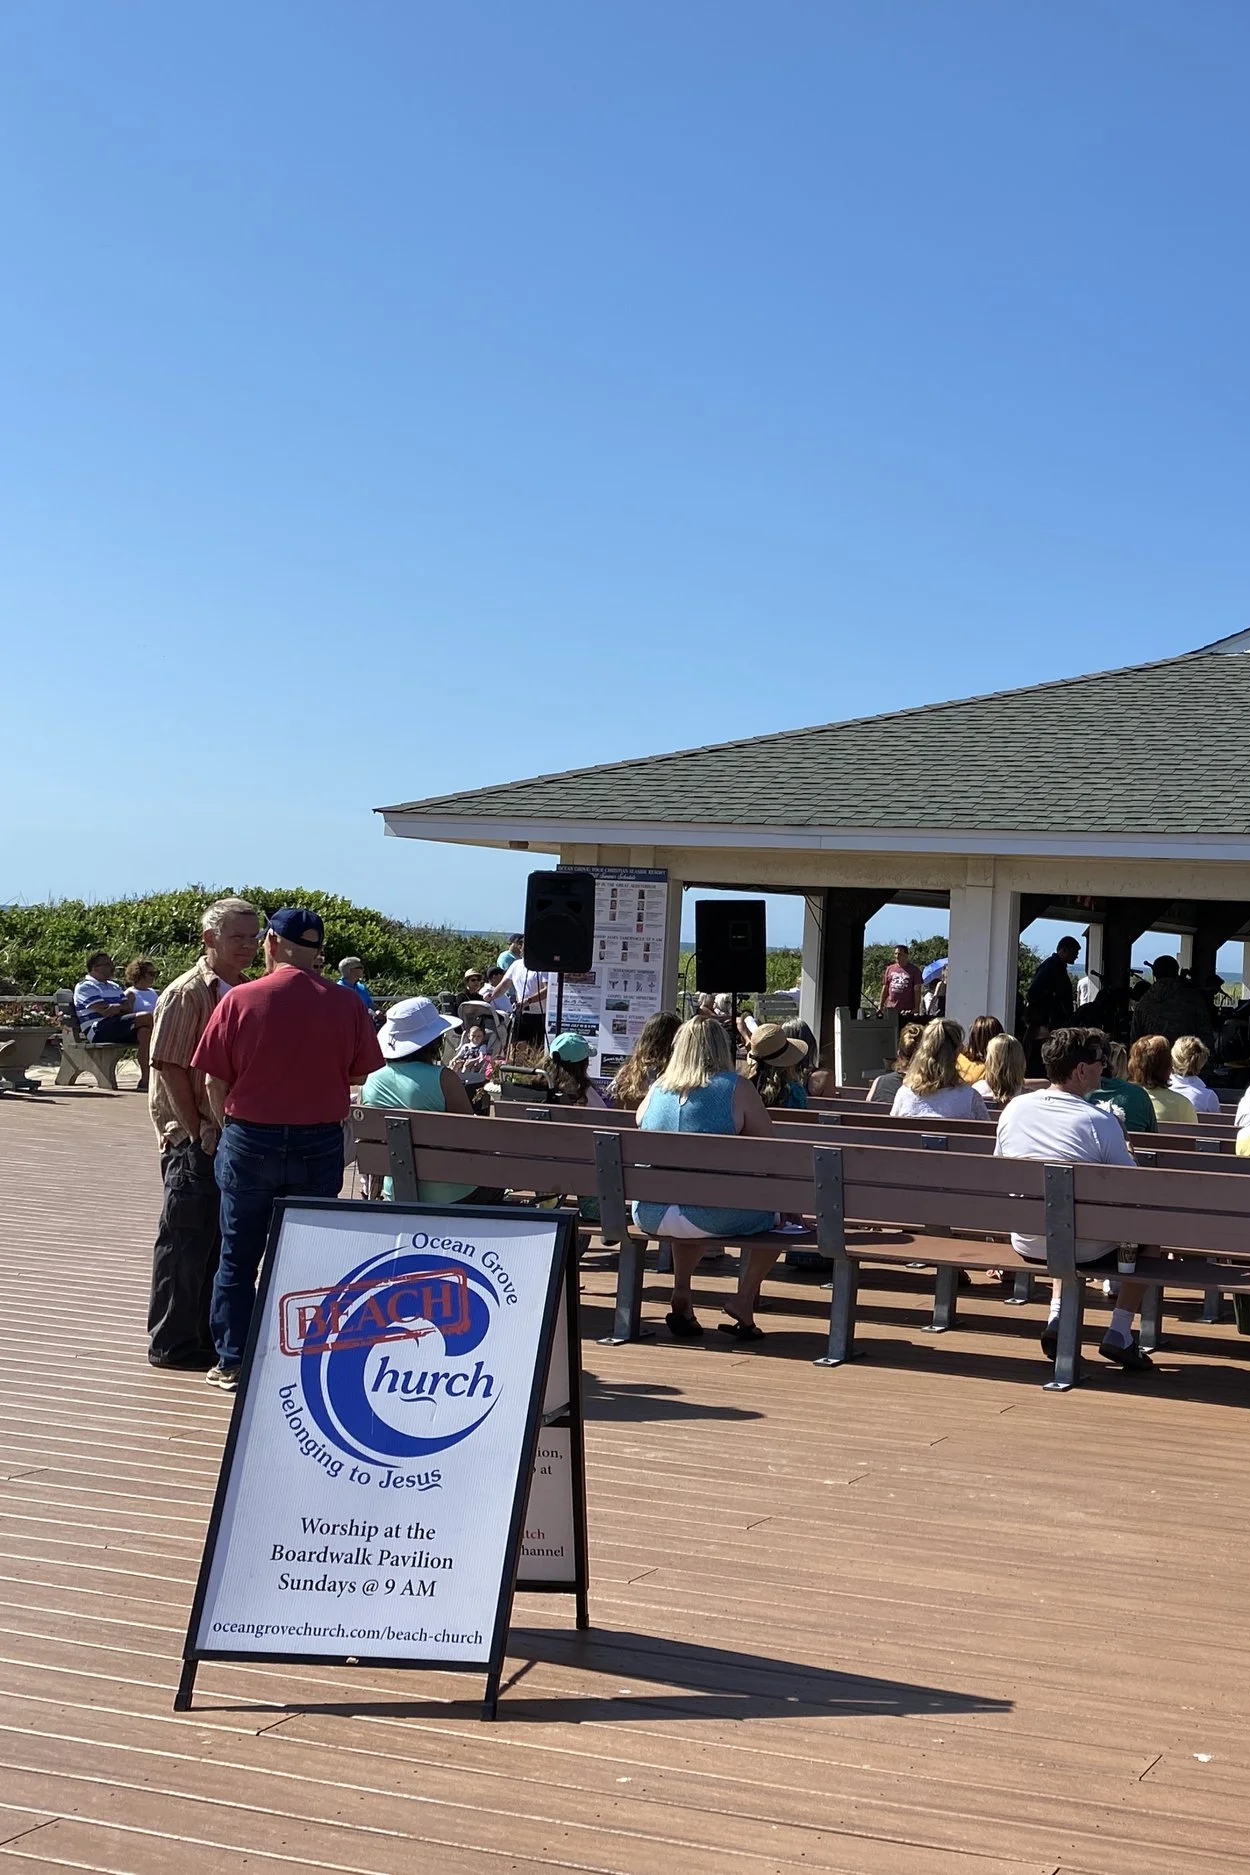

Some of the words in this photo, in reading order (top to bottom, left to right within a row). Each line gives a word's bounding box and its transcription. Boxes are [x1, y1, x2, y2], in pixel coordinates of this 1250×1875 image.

[412, 1232, 477, 1257] Ocean
[481, 1251, 518, 1306] Grove
[296, 1284, 454, 1340] BEACH
[279, 1383, 344, 1478] belonging
[349, 1465, 371, 1485] to
[378, 1468, 443, 1490] Jesus
[540, 1466, 552, 1475] at
[300, 1517, 379, 1543] Worship
[384, 1523, 402, 1539] at
[406, 1522, 436, 1541] the
[524, 1529, 545, 1539] tch
[270, 1544, 374, 1566] Boardwalk
[377, 1549, 454, 1570] Pavilion
[522, 1545, 564, 1556] hannel
[278, 1573, 357, 1598] Sundays
[361, 1579, 379, 1597] @
[384, 1578, 396, 1595] 9
[400, 1579, 437, 1597] AM
[213, 1621, 483, 1645] oceangrovechurch.com/beach-church
